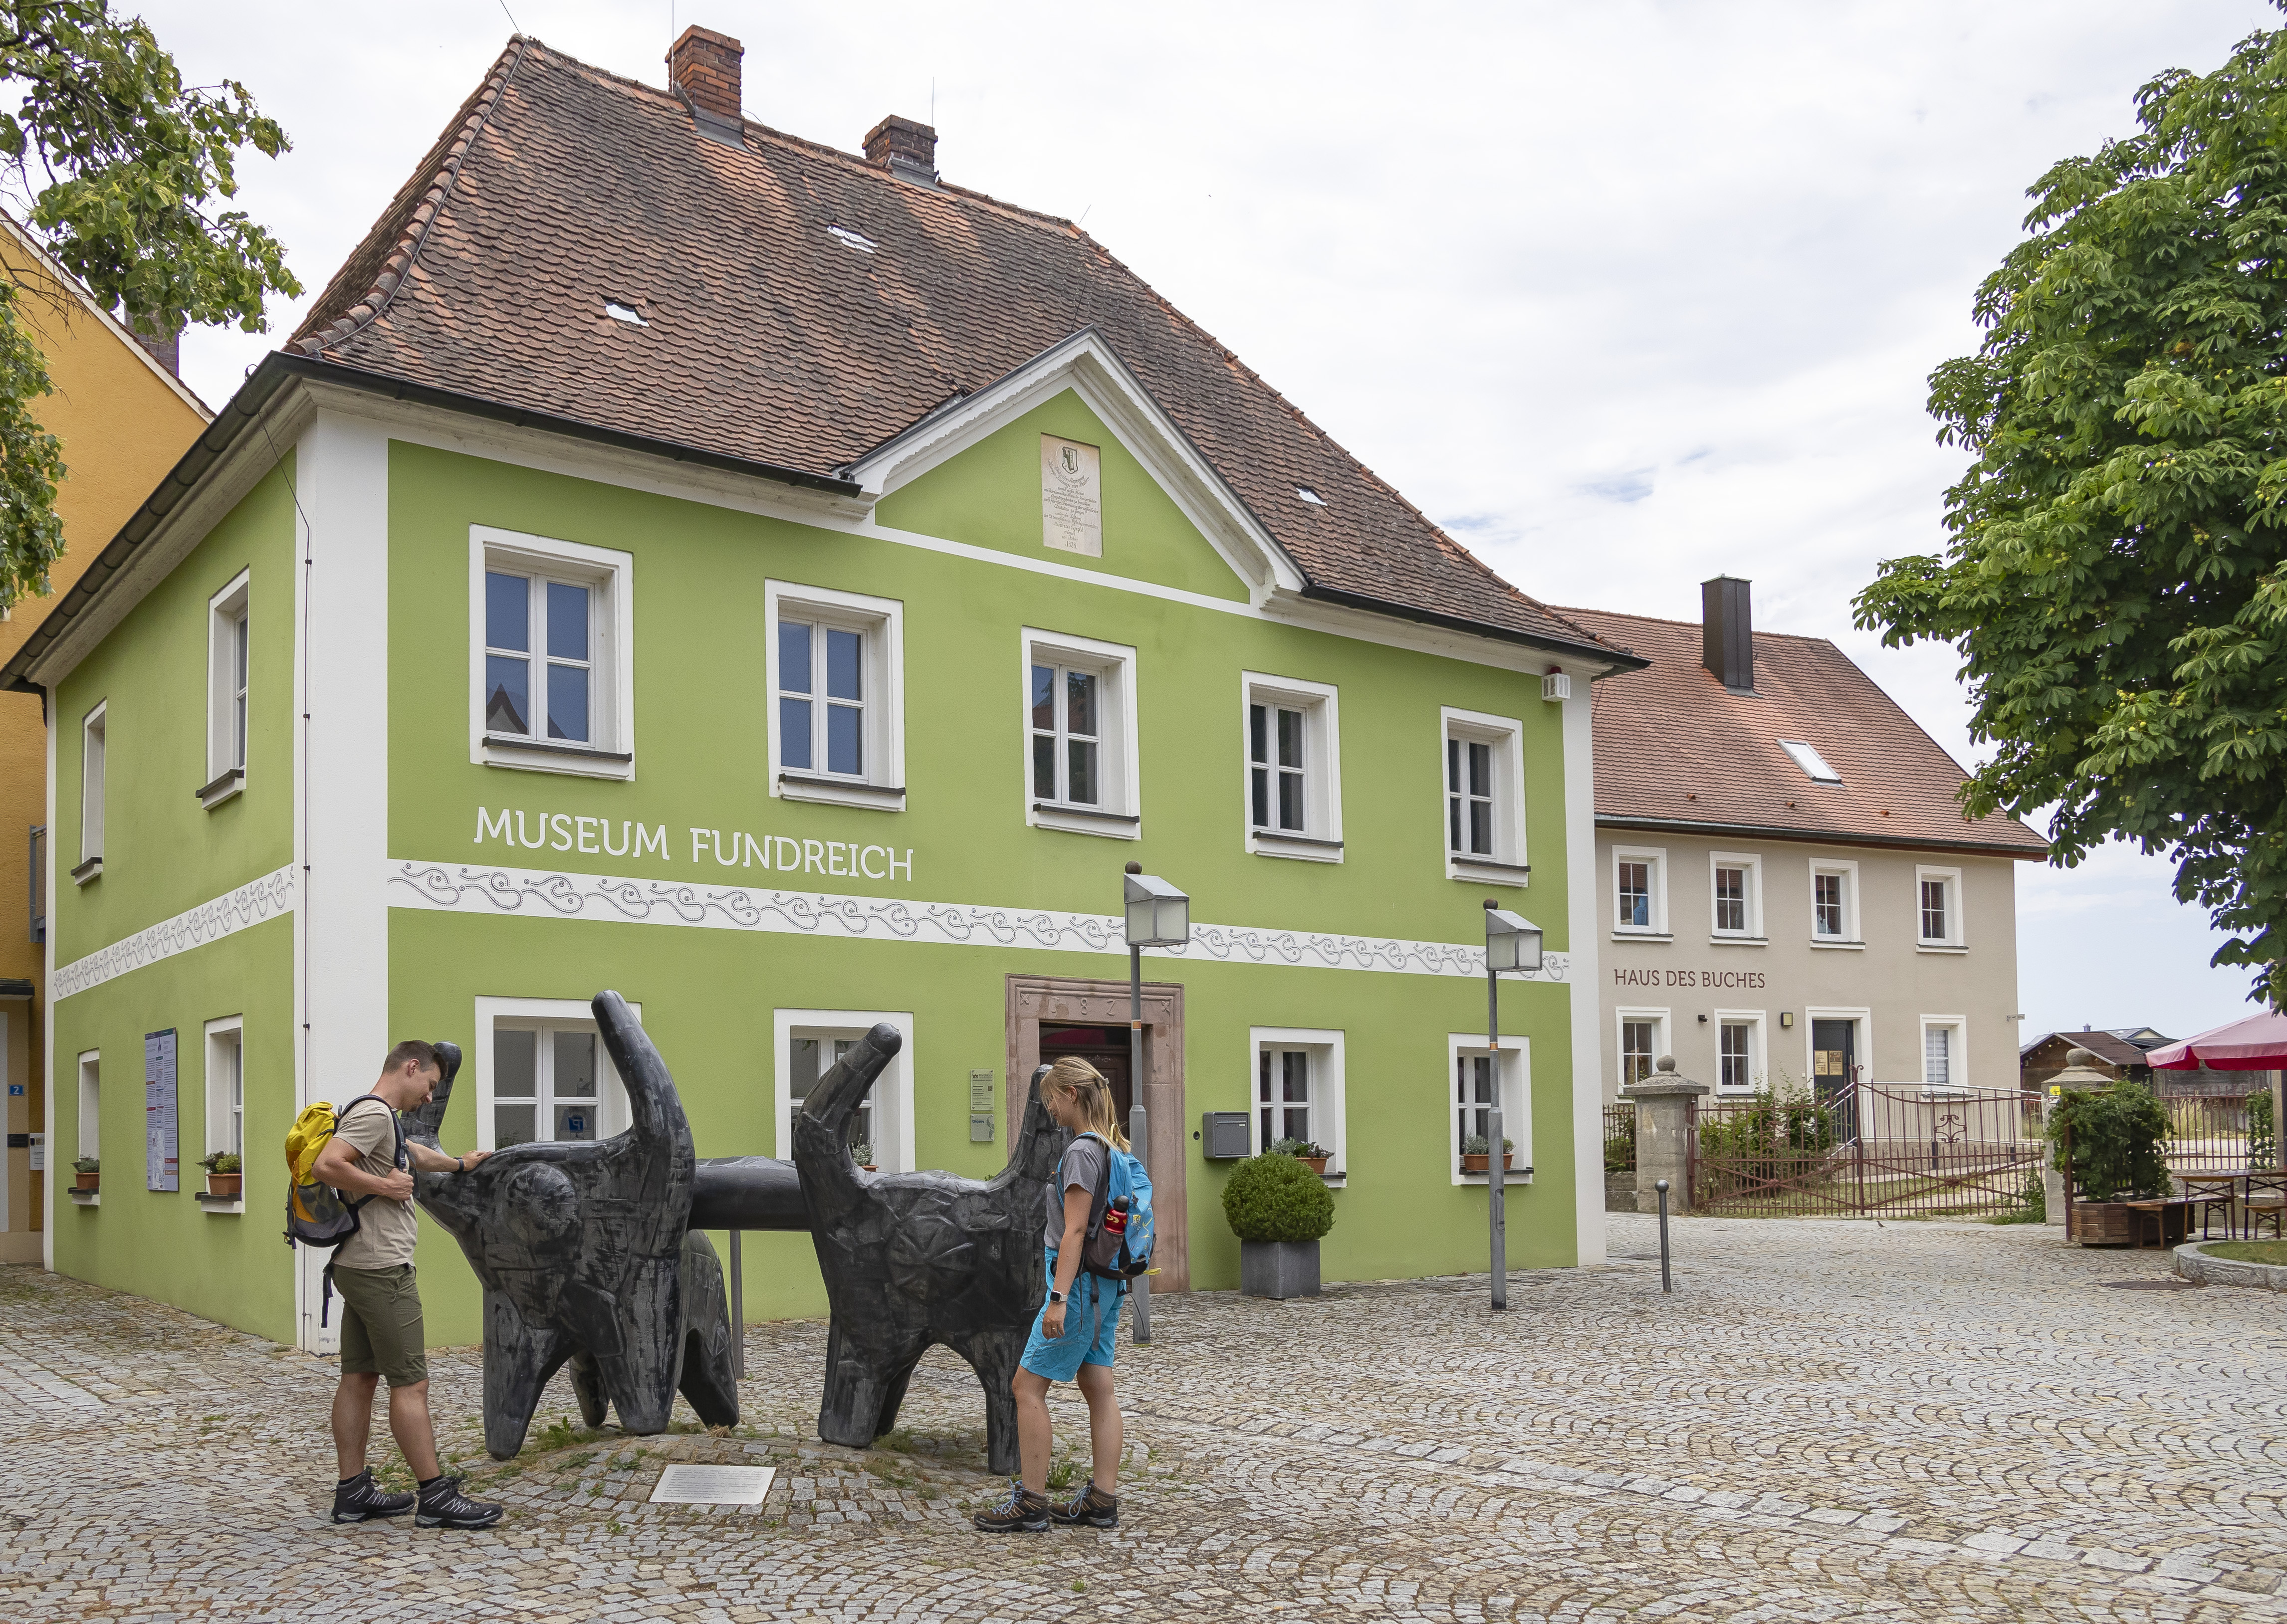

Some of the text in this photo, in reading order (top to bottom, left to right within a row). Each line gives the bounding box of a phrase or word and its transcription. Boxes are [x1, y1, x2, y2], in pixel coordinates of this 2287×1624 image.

[473, 807, 914, 881] MUSEUM FUNDREICH
[1614, 969, 1765, 988] HAUS DES BUCHES
